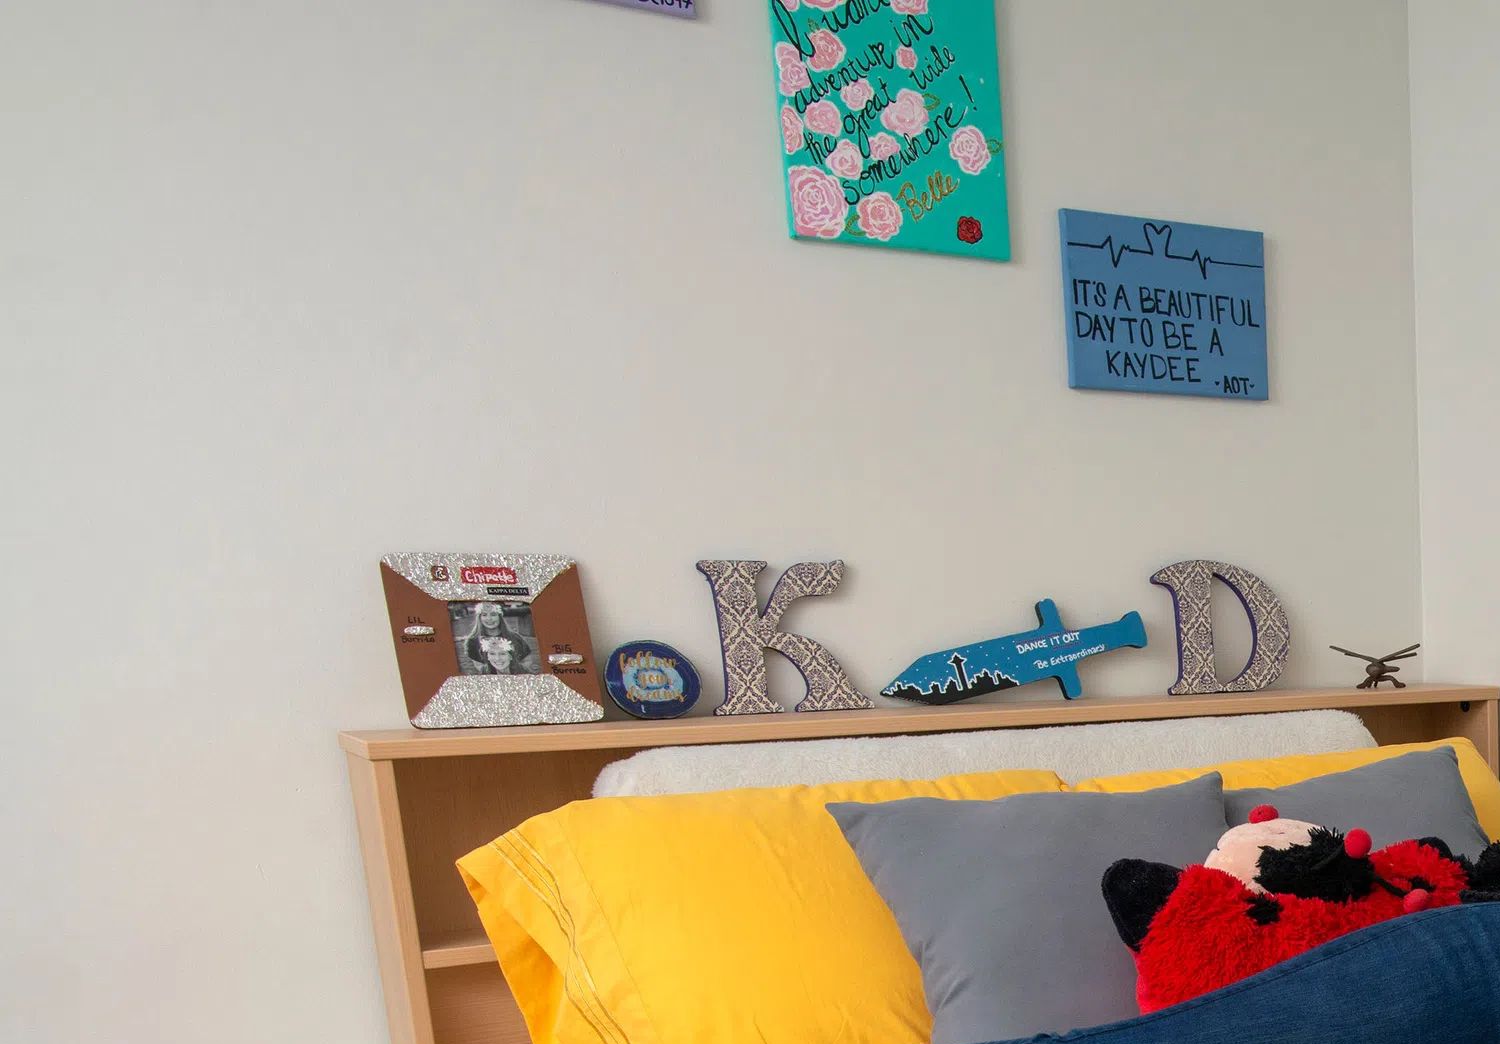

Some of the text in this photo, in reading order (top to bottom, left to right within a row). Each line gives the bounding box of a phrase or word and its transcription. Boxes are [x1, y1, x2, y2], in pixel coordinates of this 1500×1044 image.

[889, 14, 934, 48] in
[803, 45, 956, 166] the great wide
[1073, 278, 1260, 328] IT'S A BEAUTIFUL
[1075, 311, 1225, 357] DAY TO BE A
[1106, 350, 1202, 383] KAYDEE
[464, 568, 515, 584] Chipotle
[407, 616, 425, 625] LIL
[552, 643, 572, 655] BIG
[1016, 631, 1081, 655] DANCE IT OUT
[551, 665, 587, 676] Burrito
